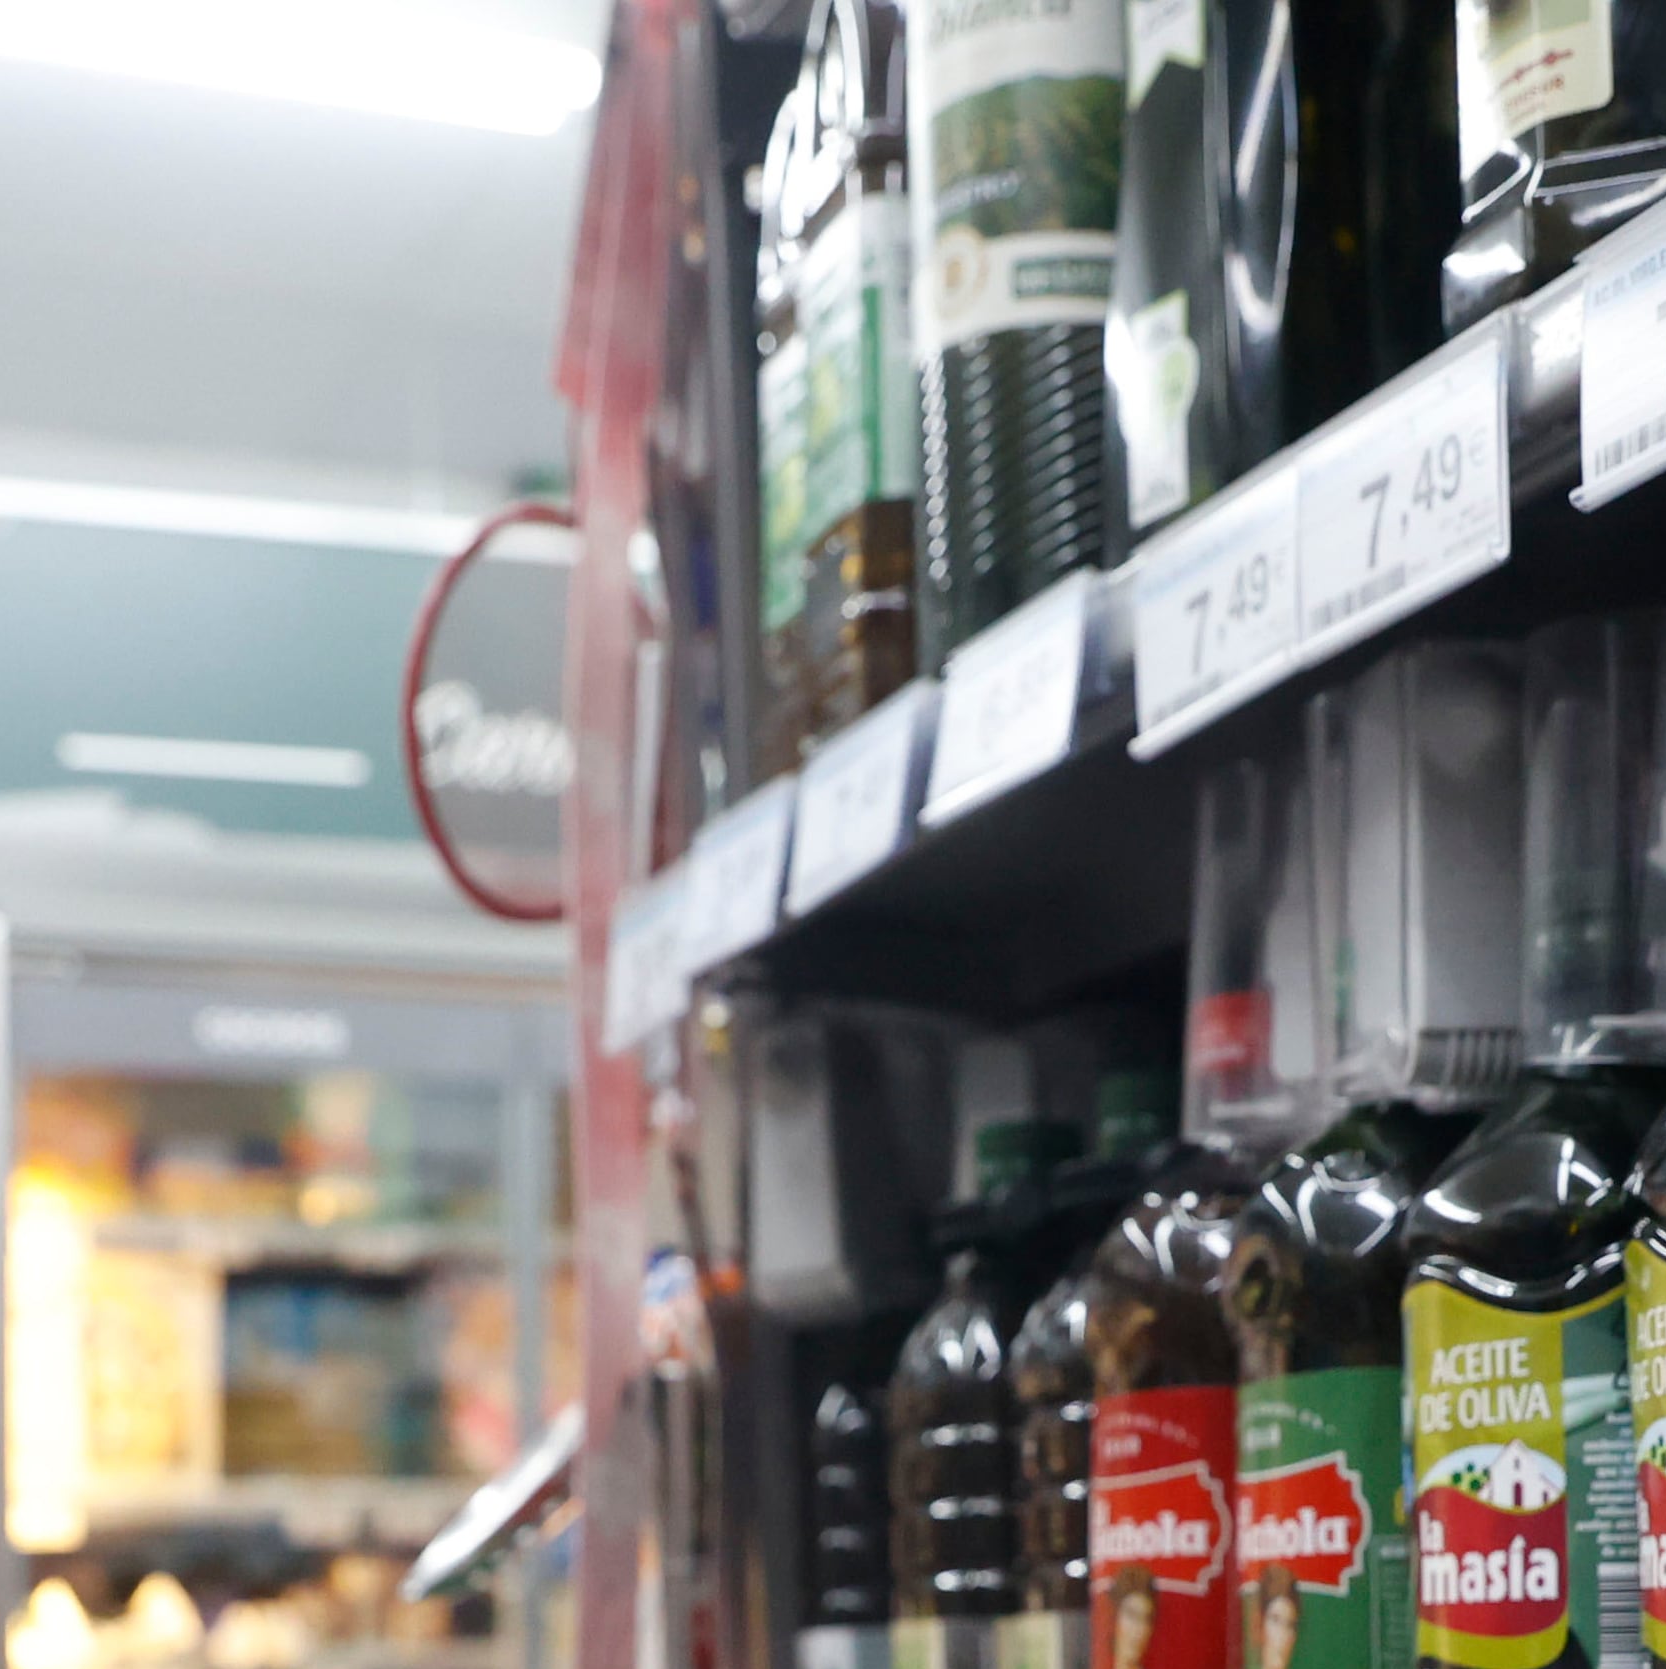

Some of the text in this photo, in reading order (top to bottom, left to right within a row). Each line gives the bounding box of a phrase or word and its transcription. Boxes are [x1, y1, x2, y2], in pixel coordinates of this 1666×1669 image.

[1431, 1338, 1530, 1387] ACEITE
[1419, 1380, 1552, 1434] DE OLIVA
[1419, 1510, 1445, 1550] la
